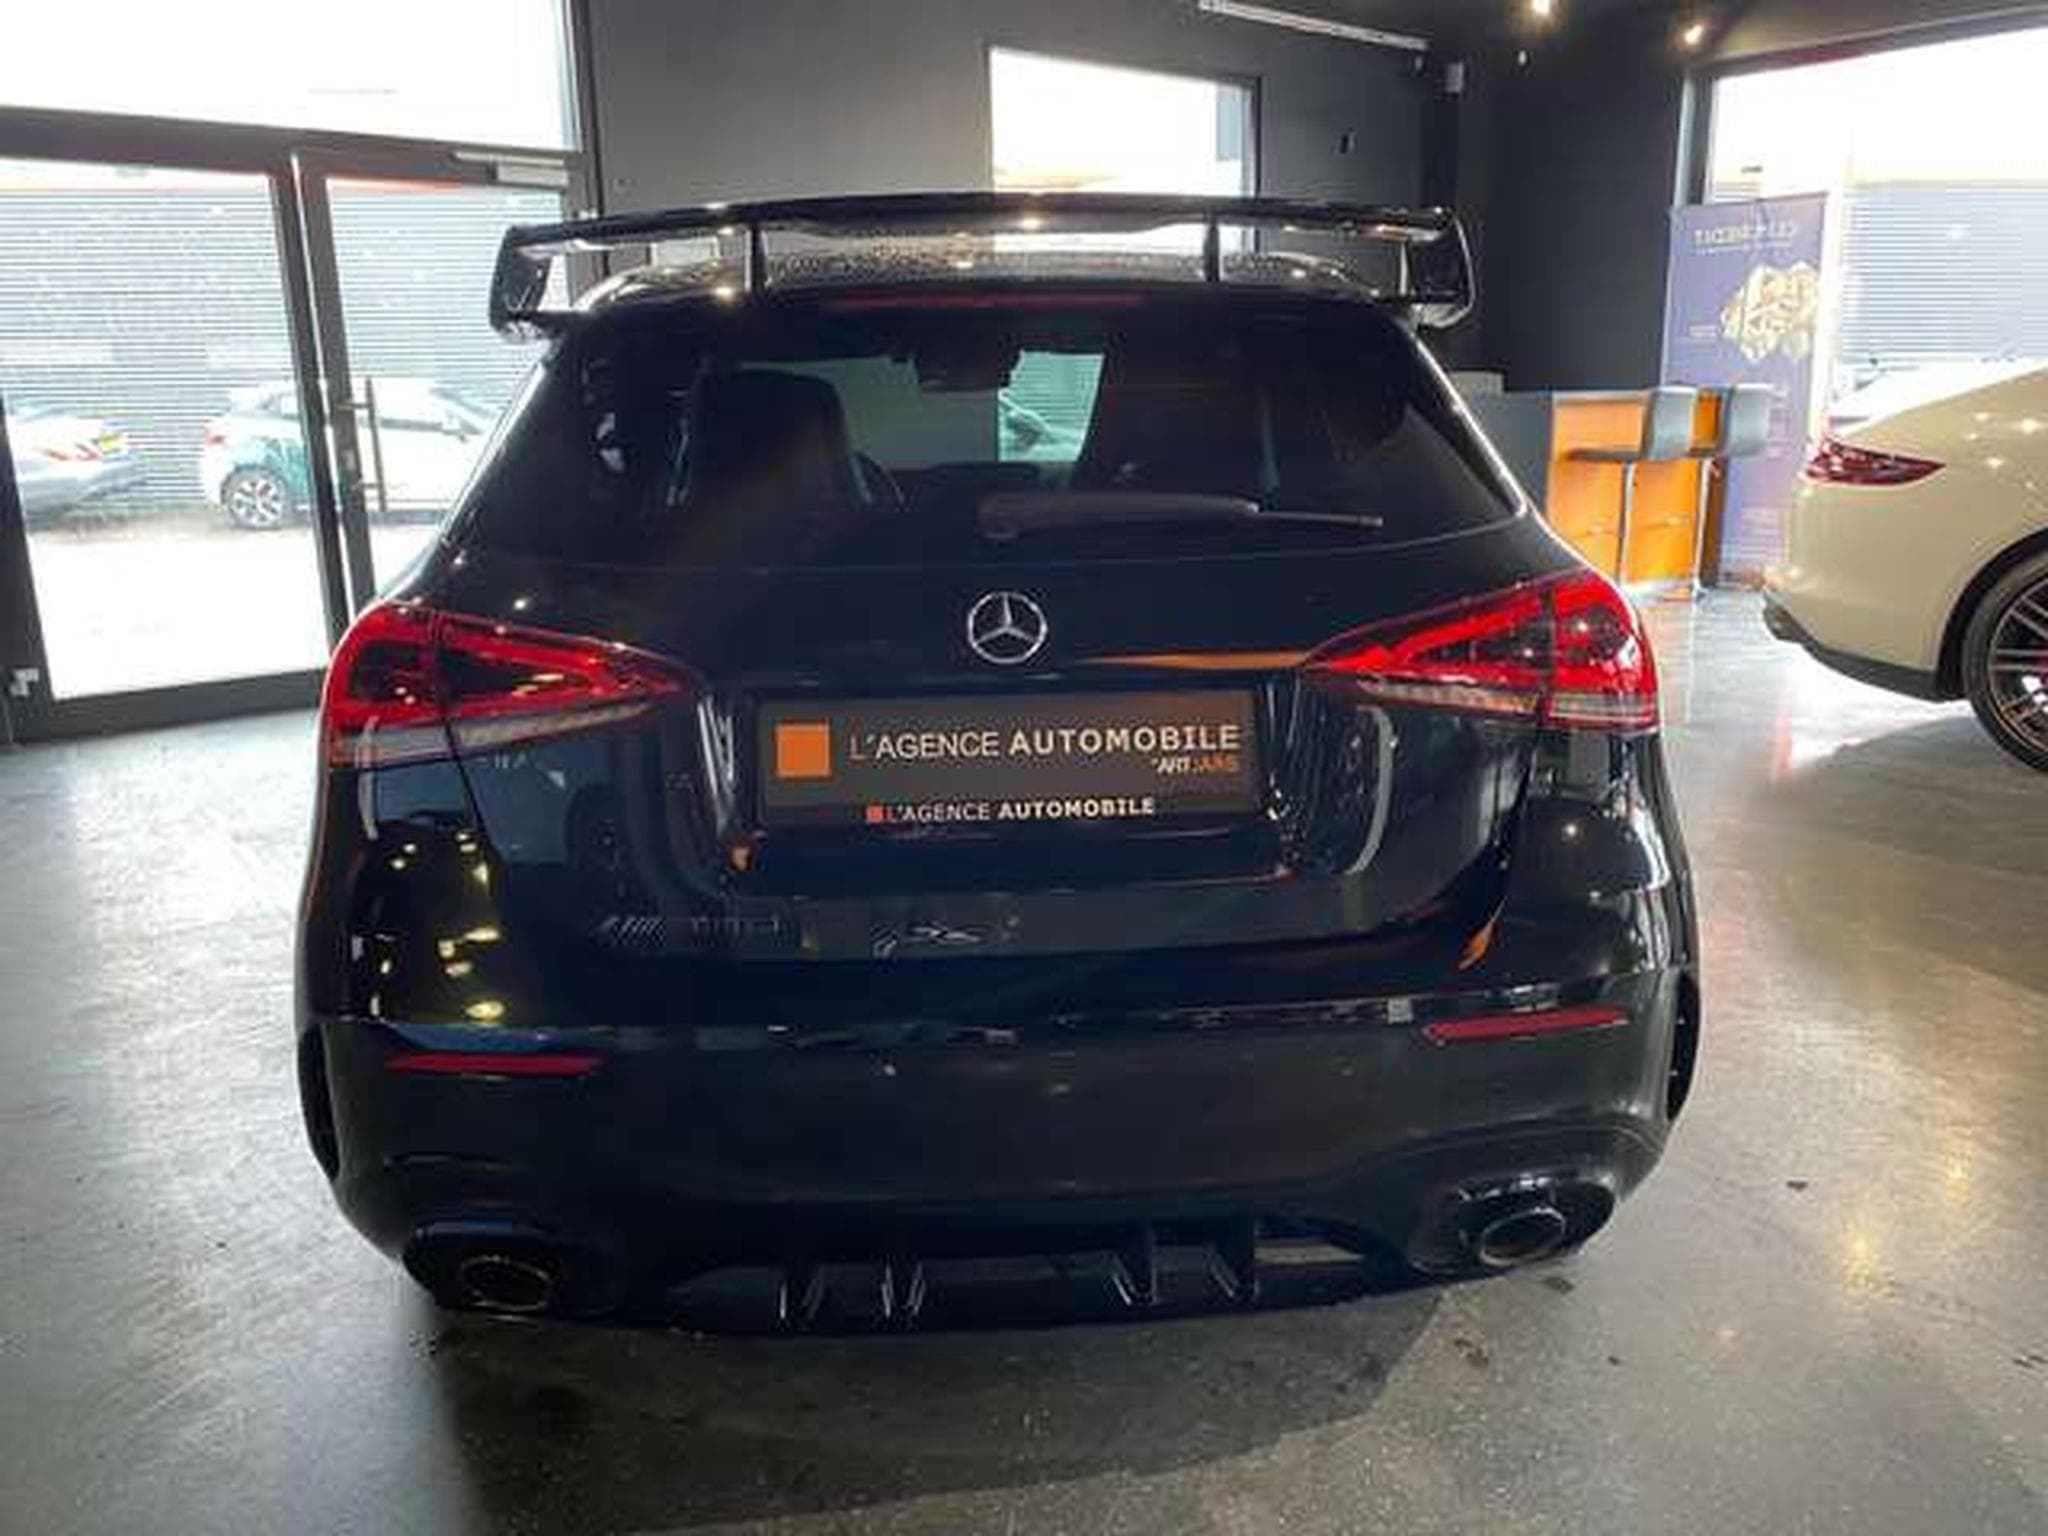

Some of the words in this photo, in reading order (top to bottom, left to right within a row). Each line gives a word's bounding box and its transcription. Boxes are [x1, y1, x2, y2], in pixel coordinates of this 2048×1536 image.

[850, 733, 999, 759] L'AGENCE
[1009, 725, 1239, 755] AUTOMOBILE
[887, 803, 990, 822] L'AGENCE
[998, 798, 1155, 819] AUTOMOBILE
